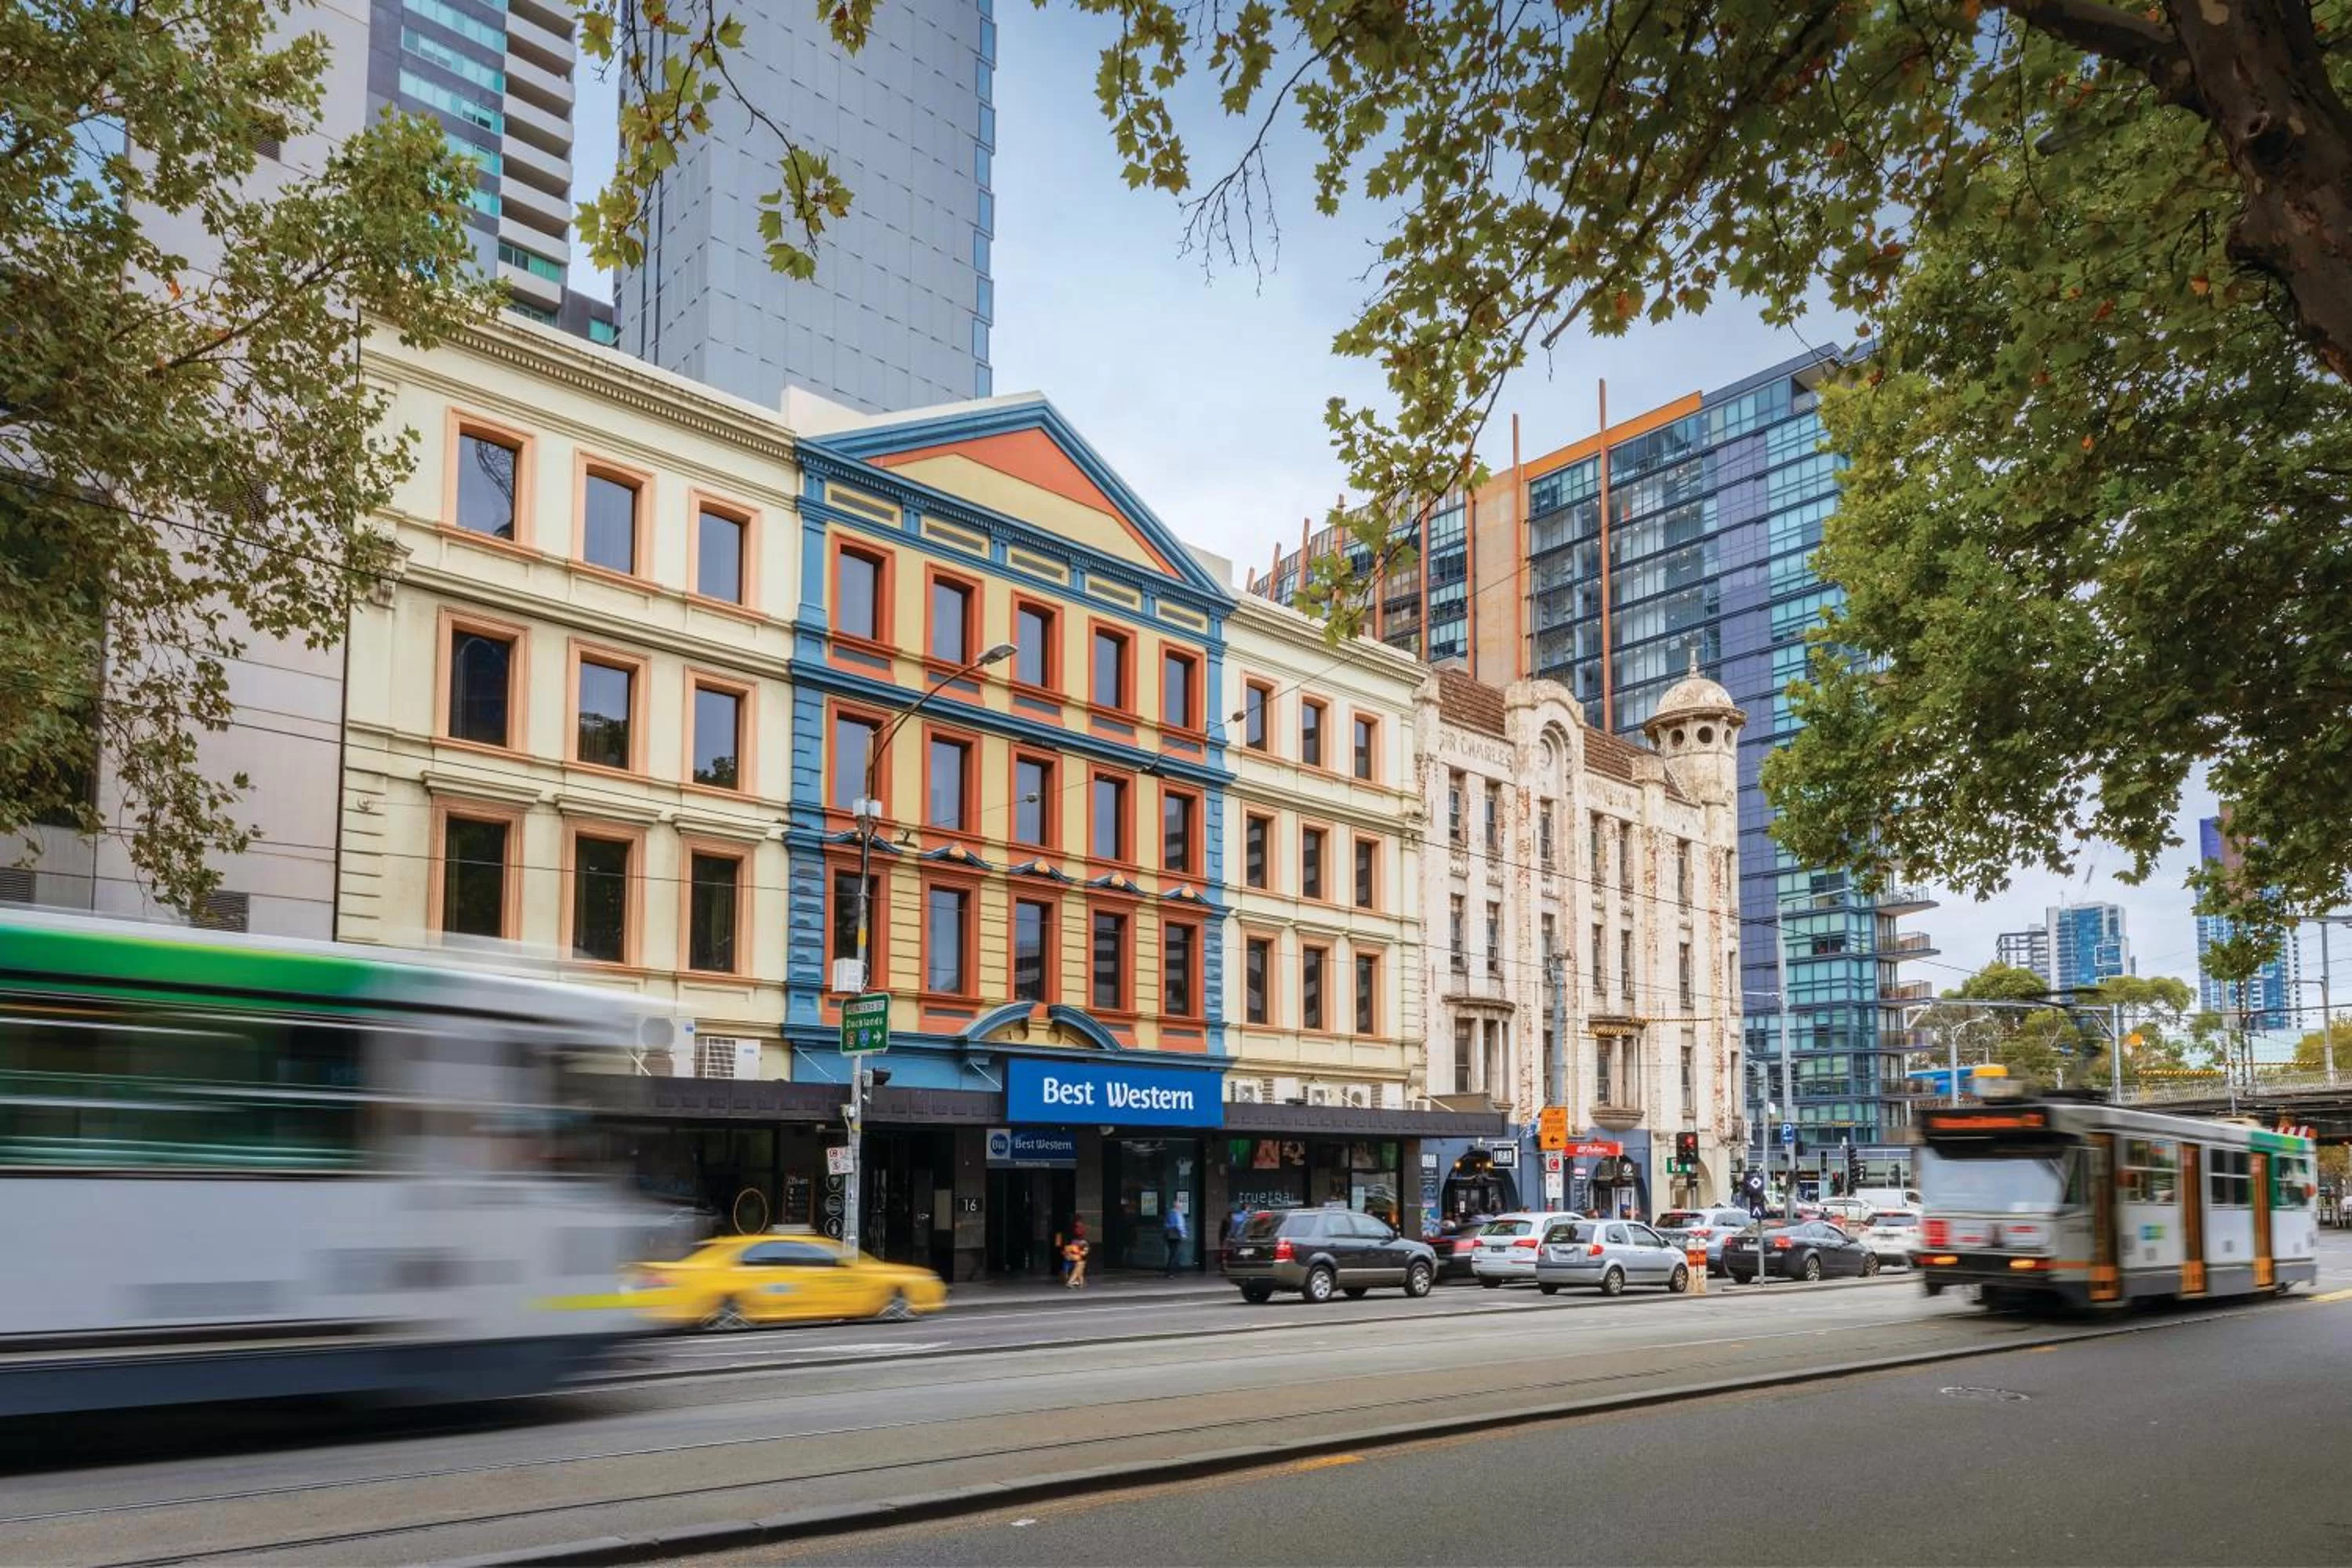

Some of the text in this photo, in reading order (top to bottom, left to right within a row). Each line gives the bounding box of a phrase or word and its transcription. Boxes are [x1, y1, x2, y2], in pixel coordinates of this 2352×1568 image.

[1043, 1077, 1194, 1110] Best Western
[1783, 1123, 1791, 1135] P
[1015, 1138, 1072, 1150] Best Western
[964, 1199, 977, 1211] 16
